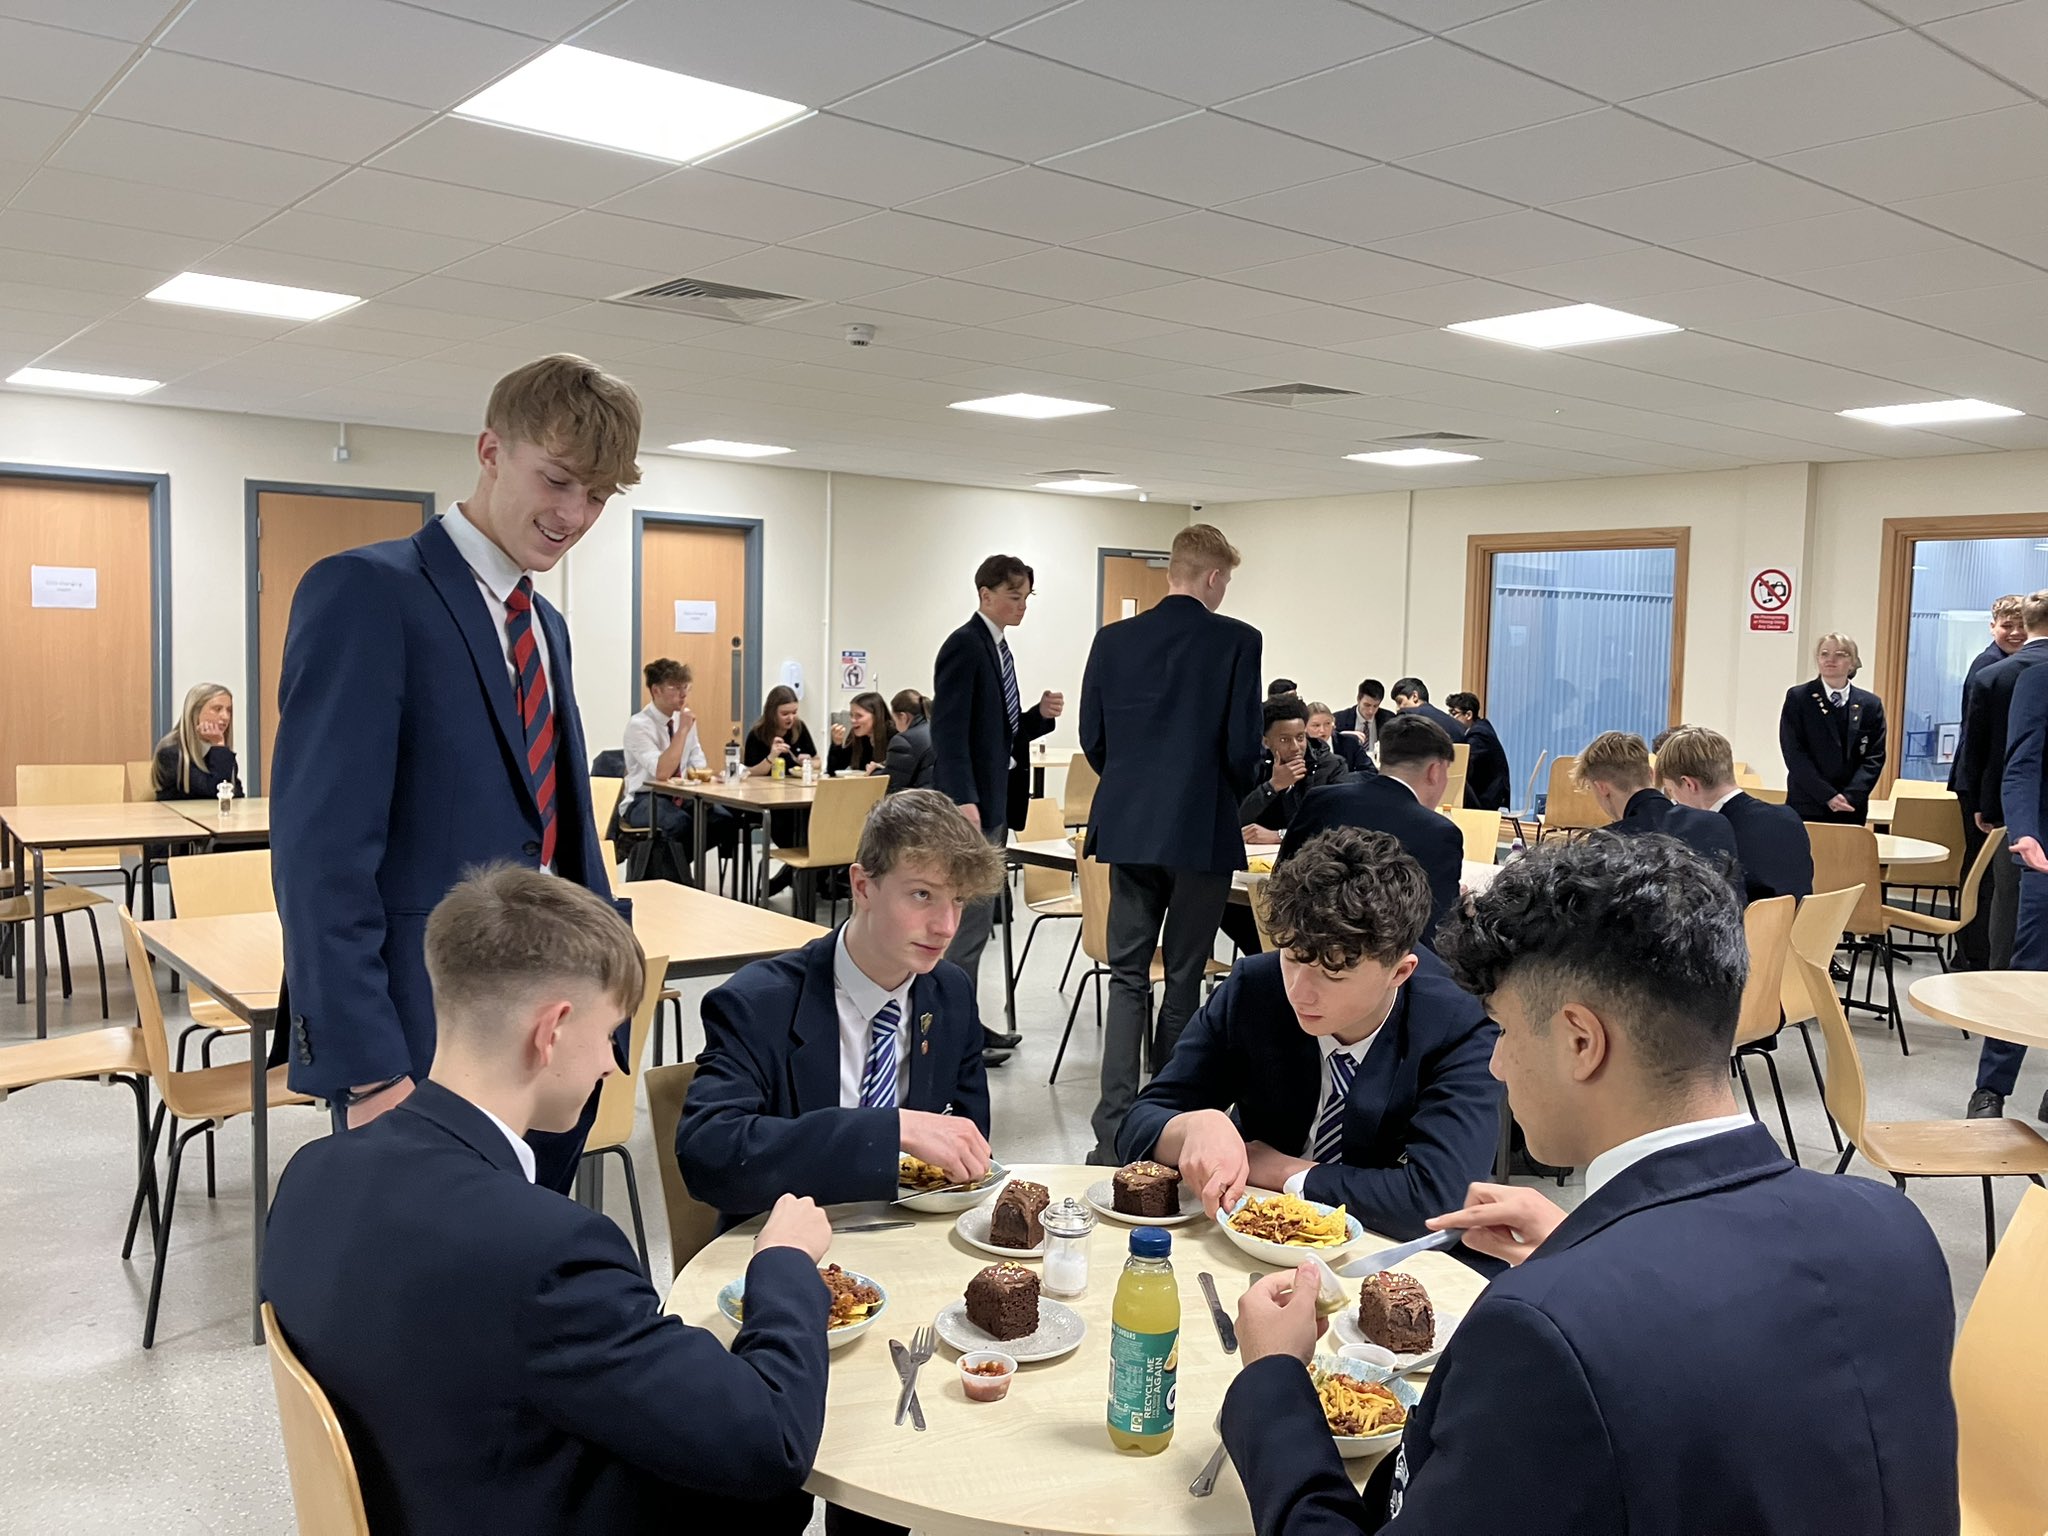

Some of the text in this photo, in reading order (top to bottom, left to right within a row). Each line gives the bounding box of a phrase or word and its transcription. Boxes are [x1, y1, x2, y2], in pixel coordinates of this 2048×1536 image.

[1144, 1357, 1154, 1419] RECYCLE ME
[1153, 1357, 1163, 1394] AGAIN
